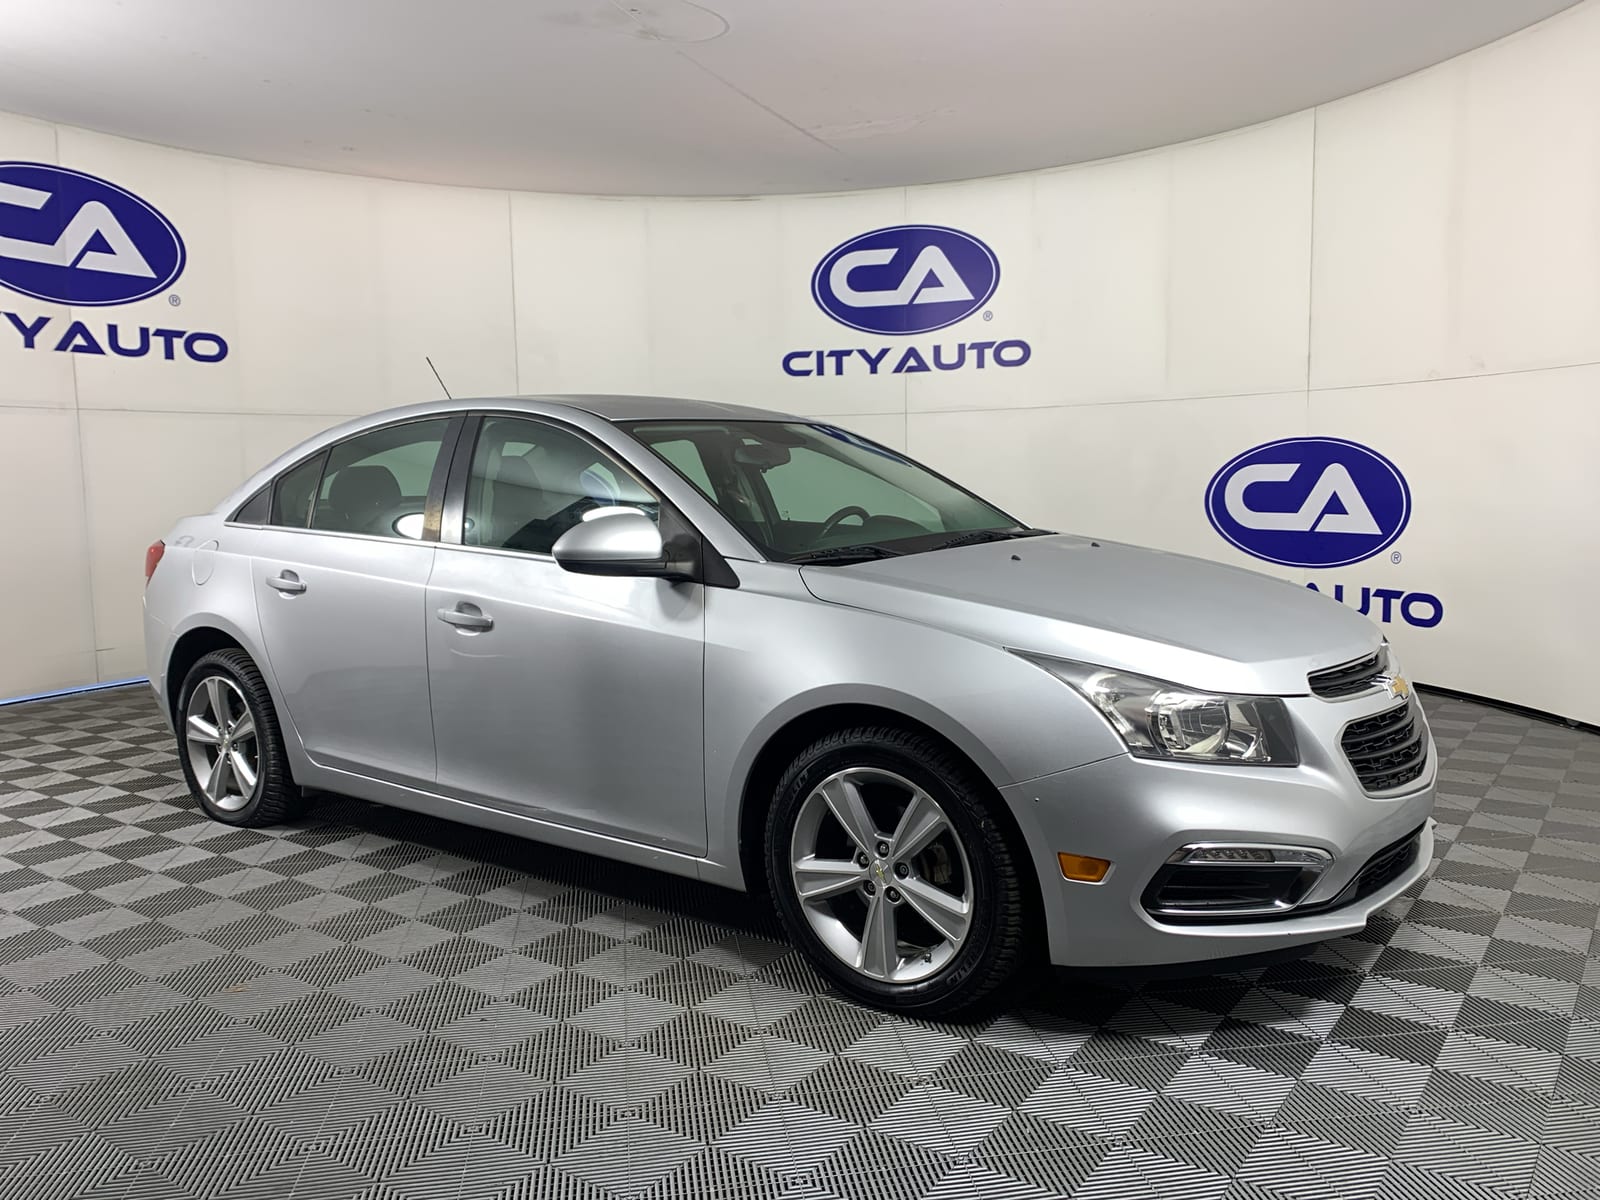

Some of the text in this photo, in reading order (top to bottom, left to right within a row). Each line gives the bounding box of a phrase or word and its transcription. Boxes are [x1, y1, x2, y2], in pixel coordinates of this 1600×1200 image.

[829, 245, 976, 308] CA
[1224, 462, 1383, 535] CA
[1306, 582, 1444, 629] UTO
